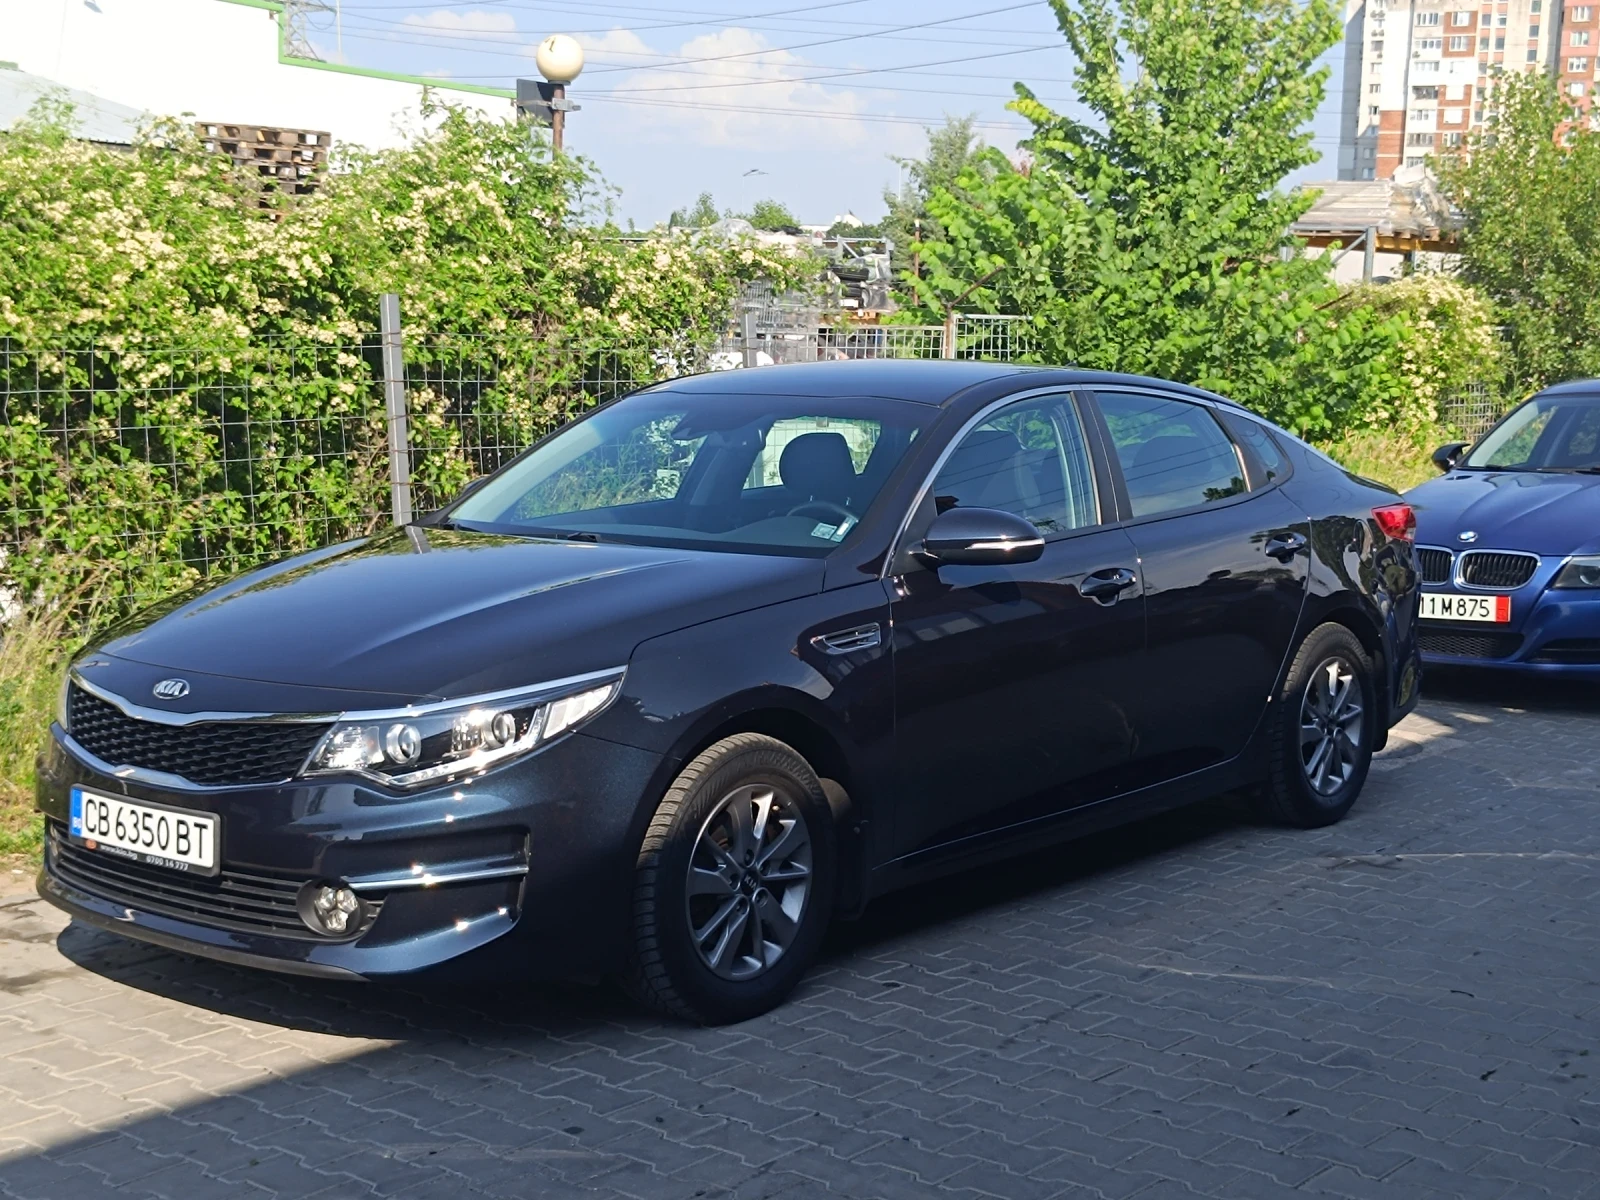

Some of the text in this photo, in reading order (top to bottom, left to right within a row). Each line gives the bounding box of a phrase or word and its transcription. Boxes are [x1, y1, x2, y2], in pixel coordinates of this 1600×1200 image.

[155, 680, 184, 696] KIA
[85, 799, 209, 859] CB 6350 BT
[145, 855, 164, 867] 0700
[174, 861, 189, 872] 777
[744, 874, 757, 889] KIA
